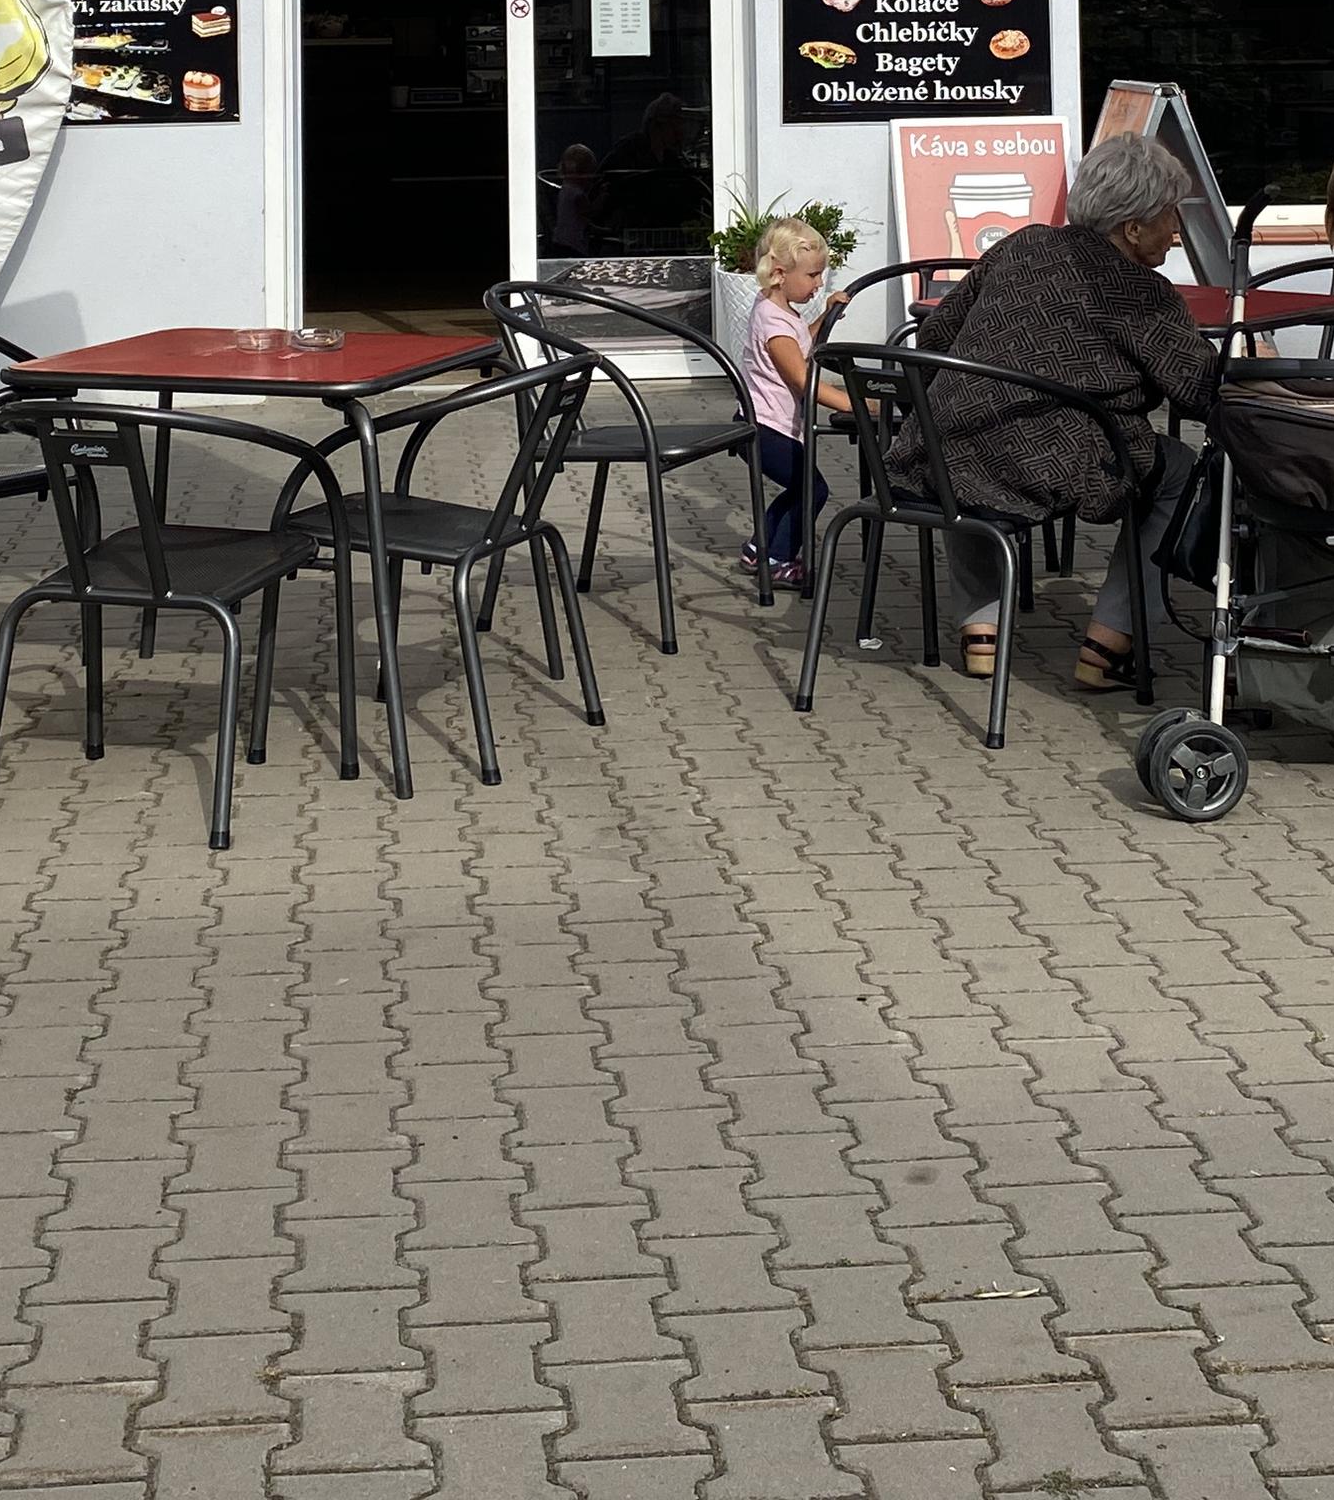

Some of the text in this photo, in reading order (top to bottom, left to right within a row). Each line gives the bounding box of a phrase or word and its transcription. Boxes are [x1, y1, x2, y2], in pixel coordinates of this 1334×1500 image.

[855, 23, 979, 46] Chlebíčky
[875, 53, 960, 76] Bagety
[812, 79, 1025, 104] Obložené housky
[909, 131, 1057, 158] Káva s sebou
